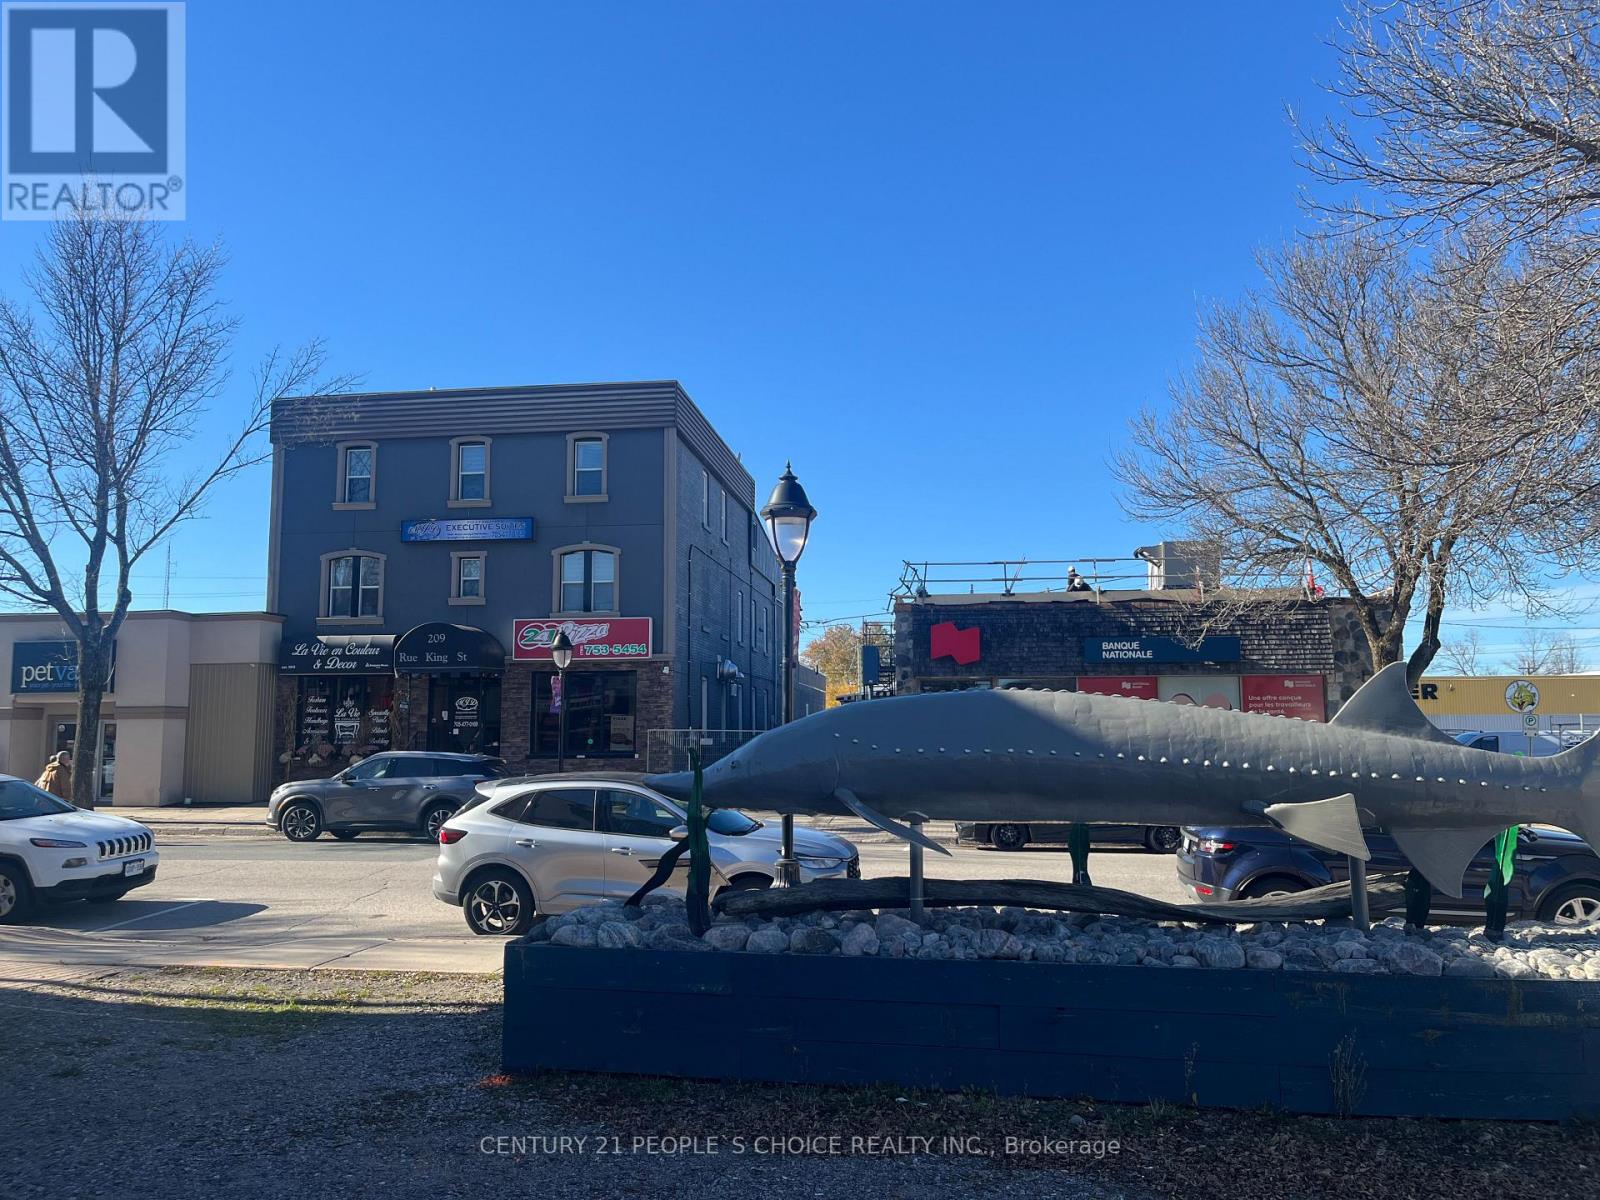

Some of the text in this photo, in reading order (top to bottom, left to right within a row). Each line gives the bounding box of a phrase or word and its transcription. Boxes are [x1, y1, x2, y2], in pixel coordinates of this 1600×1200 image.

[445, 523, 493, 531] EXECUTIVE
[427, 633, 446, 643] 209
[559, 620, 610, 646] Pizza
[292, 643, 309, 656] La
[311, 643, 329, 656] Vie
[345, 642, 380, 656] Couleur
[1102, 641, 1140, 650] BANQUE
[399, 651, 467, 663] Rue King St
[1102, 650, 1153, 659] NATIONALE
[313, 659, 322, 669] &
[324, 656, 358, 670] Decor
[334, 707, 361, 717] La Vie
